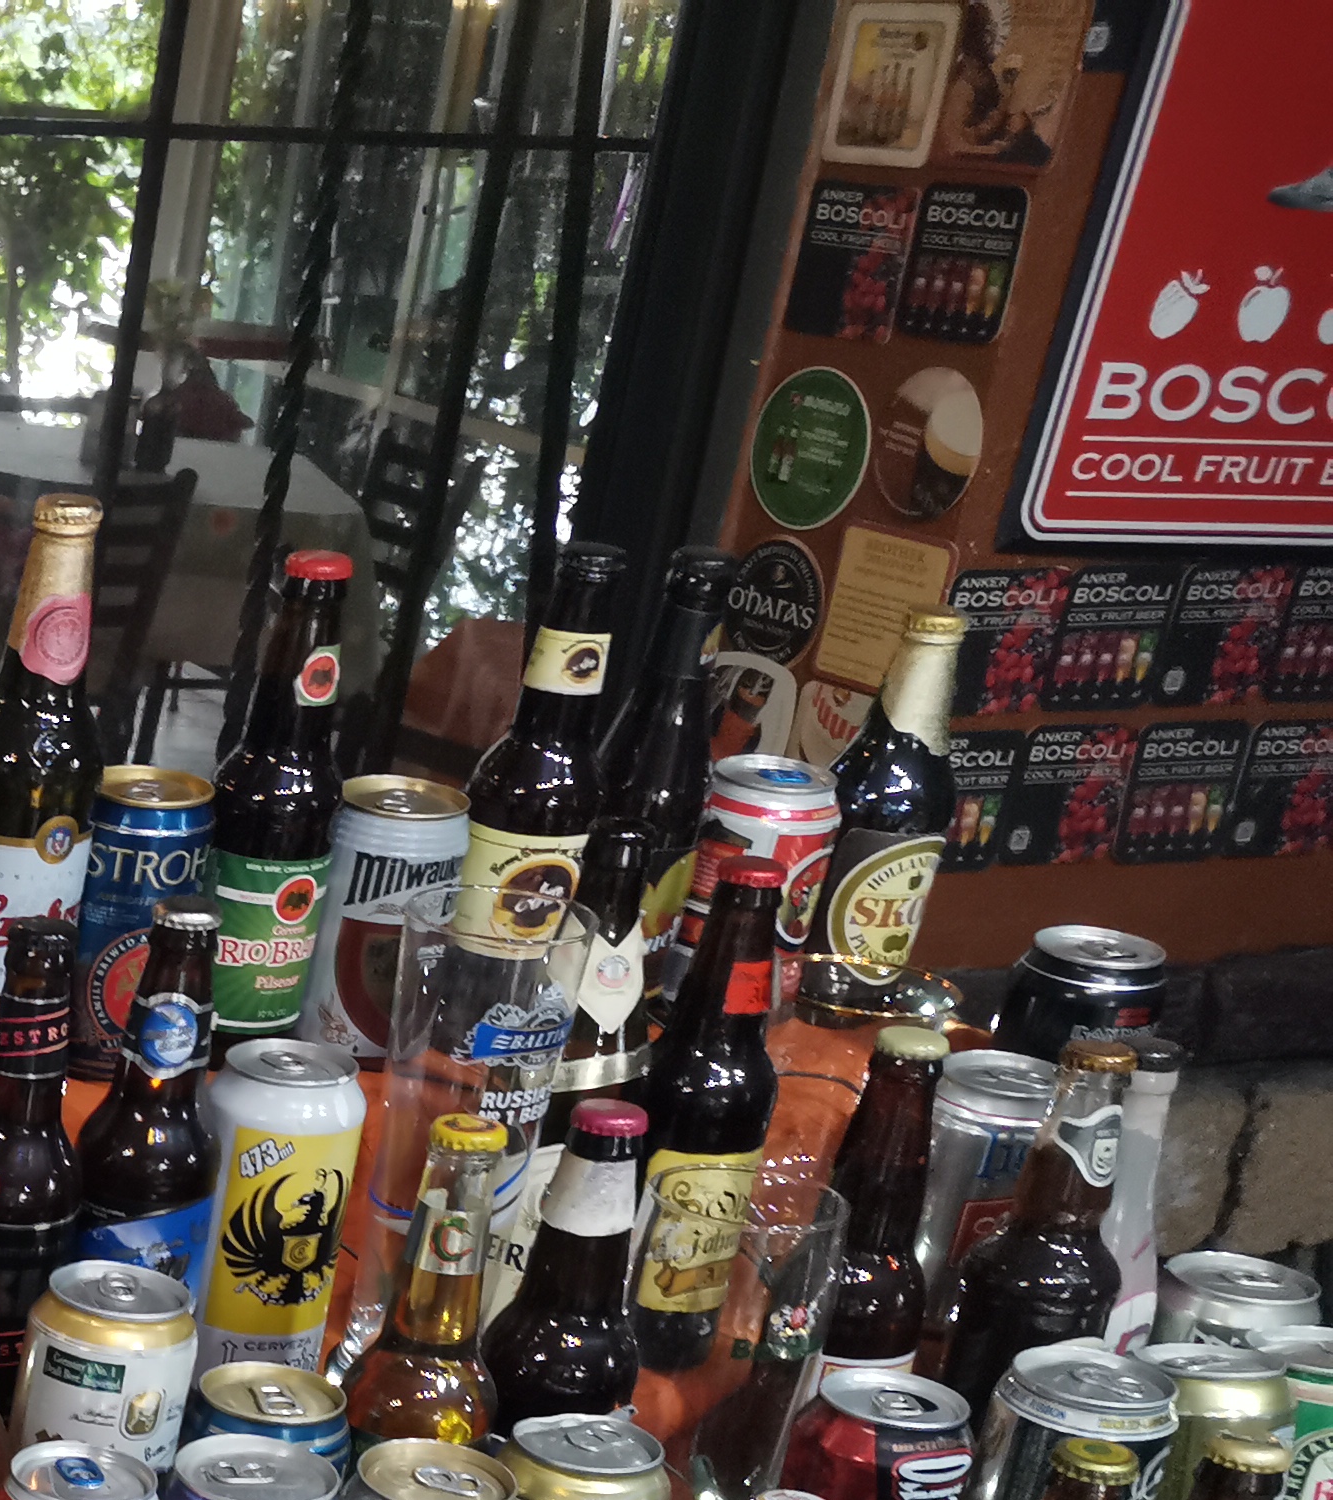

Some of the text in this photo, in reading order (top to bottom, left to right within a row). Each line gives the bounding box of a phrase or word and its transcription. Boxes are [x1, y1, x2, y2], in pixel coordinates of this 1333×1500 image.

[927, 205, 1019, 230] BOSCOLI
[1085, 360, 1333, 426] BOSC
[1071, 452, 1183, 482] COOL
[1194, 455, 1314, 485] FRUIT
[960, 575, 1010, 590] ANKER
[1079, 571, 1128, 585] ANKER
[953, 587, 1057, 610] BOSCOLI
[1072, 584, 1174, 604] BOSCOLI
[1186, 582, 1284, 601] BOSCOLI
[1034, 731, 1083, 744] ANKER
[1028, 743, 1127, 763] BOSCOLI
[1142, 739, 1239, 759] BOSCOLI
[949, 749, 1015, 770] SCOLI
[218, 939, 268, 965] RIO
[238, 1137, 281, 1179] 473
